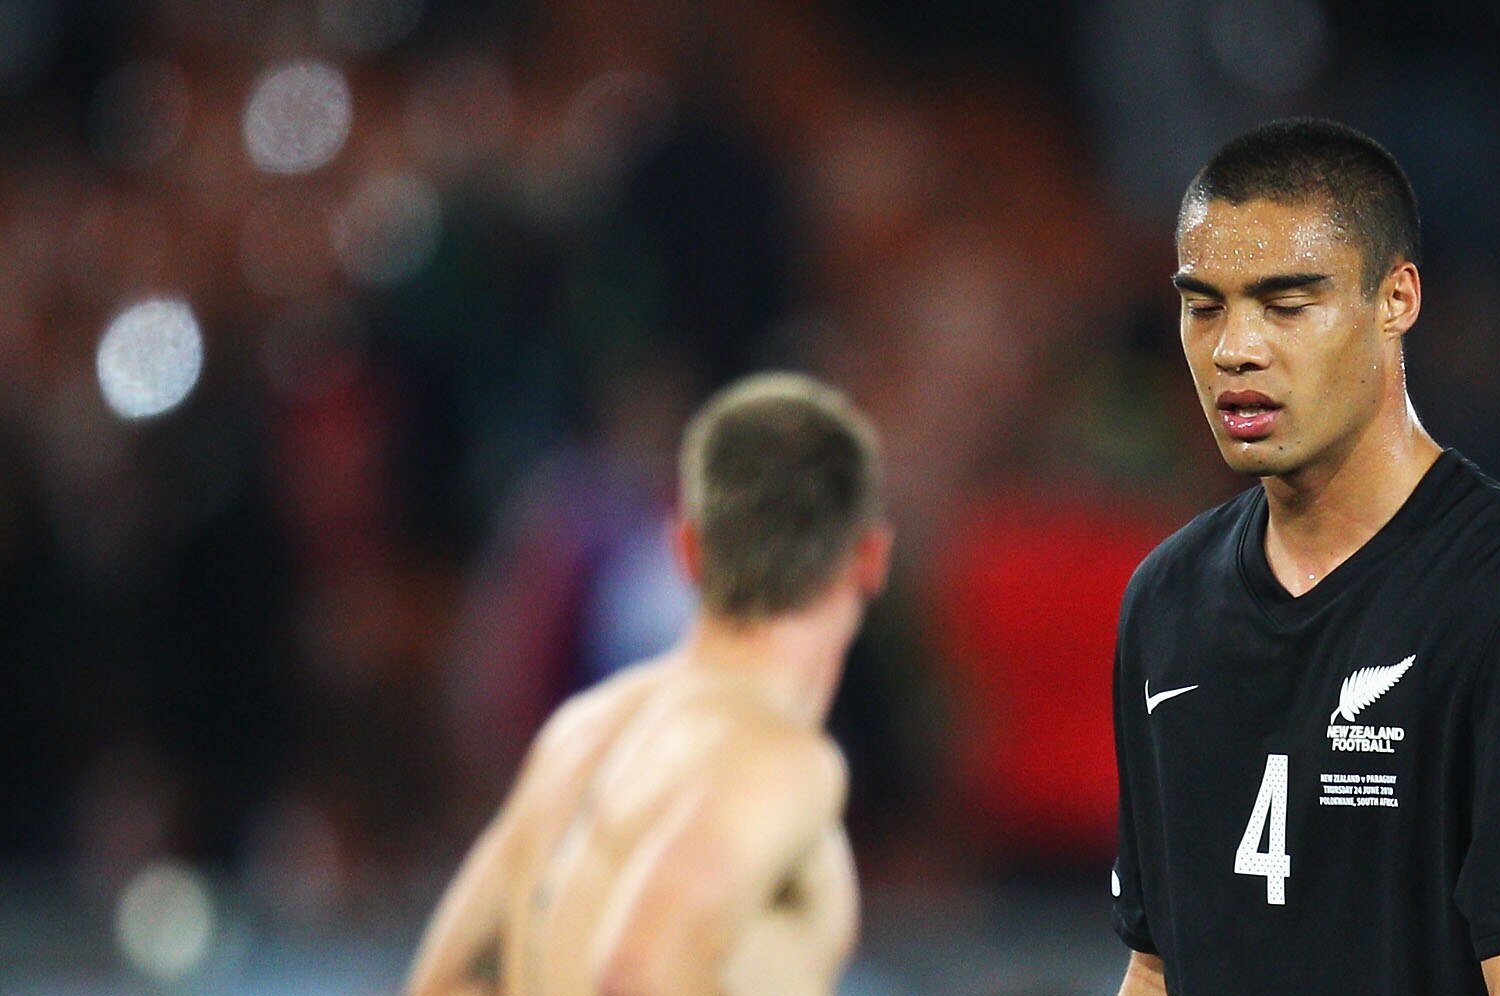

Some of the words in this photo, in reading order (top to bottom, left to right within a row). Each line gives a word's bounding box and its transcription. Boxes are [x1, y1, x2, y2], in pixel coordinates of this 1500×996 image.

[1327, 725, 1349, 738] NEW
[1349, 726, 1405, 740] ZEALAND
[1332, 739, 1395, 753] FOOTBALL
[1320, 774, 1333, 783] NEW
[1333, 774, 1360, 783] ZEALAND
[1323, 785, 1353, 794] THURSDAY
[1353, 786, 1362, 795] 24
[1362, 786, 1380, 795] JUNE
[1356, 797, 1379, 806] SOUTH
[1234, 754, 1291, 905] 4
